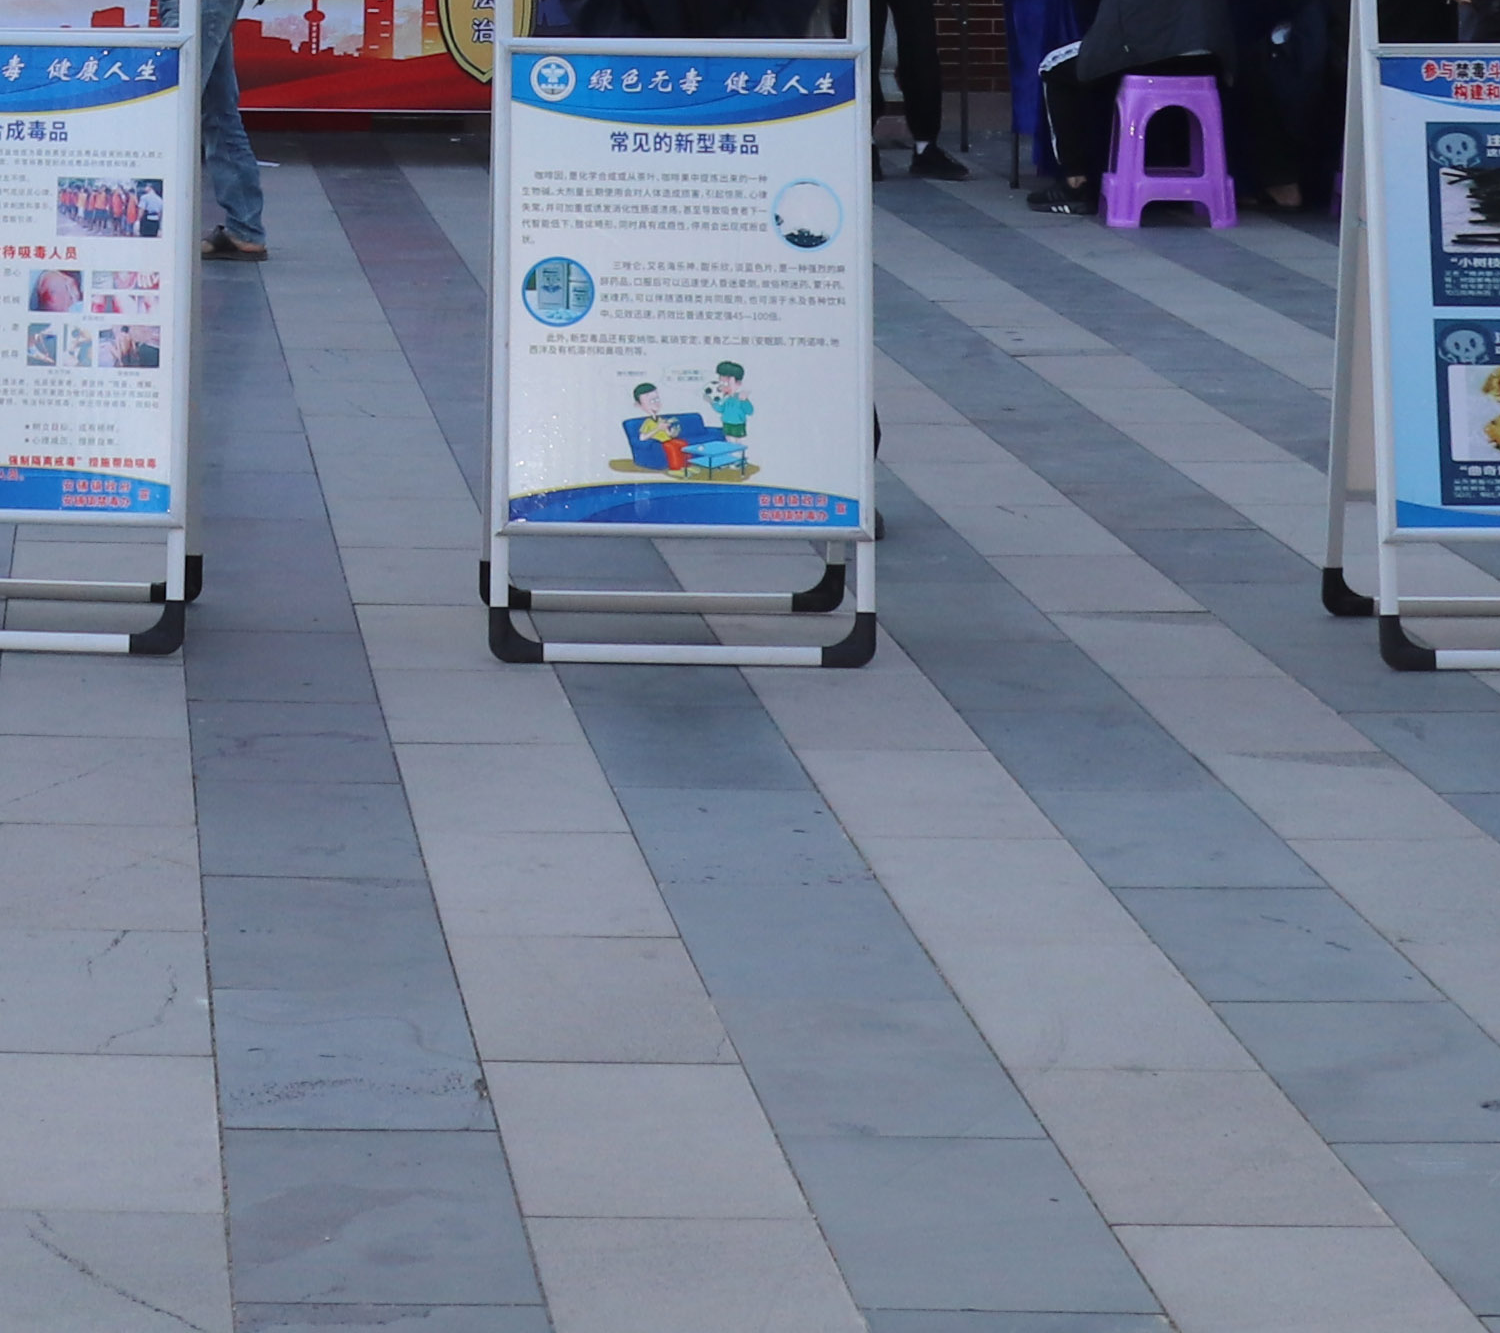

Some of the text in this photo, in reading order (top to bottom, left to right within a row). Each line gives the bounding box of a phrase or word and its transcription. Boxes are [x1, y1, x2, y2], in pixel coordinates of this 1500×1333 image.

[47, 55, 159, 82] 健康人生
[588, 68, 837, 97] 绿色无毒 健康人生
[610, 131, 760, 156] 常见的新型毒品
